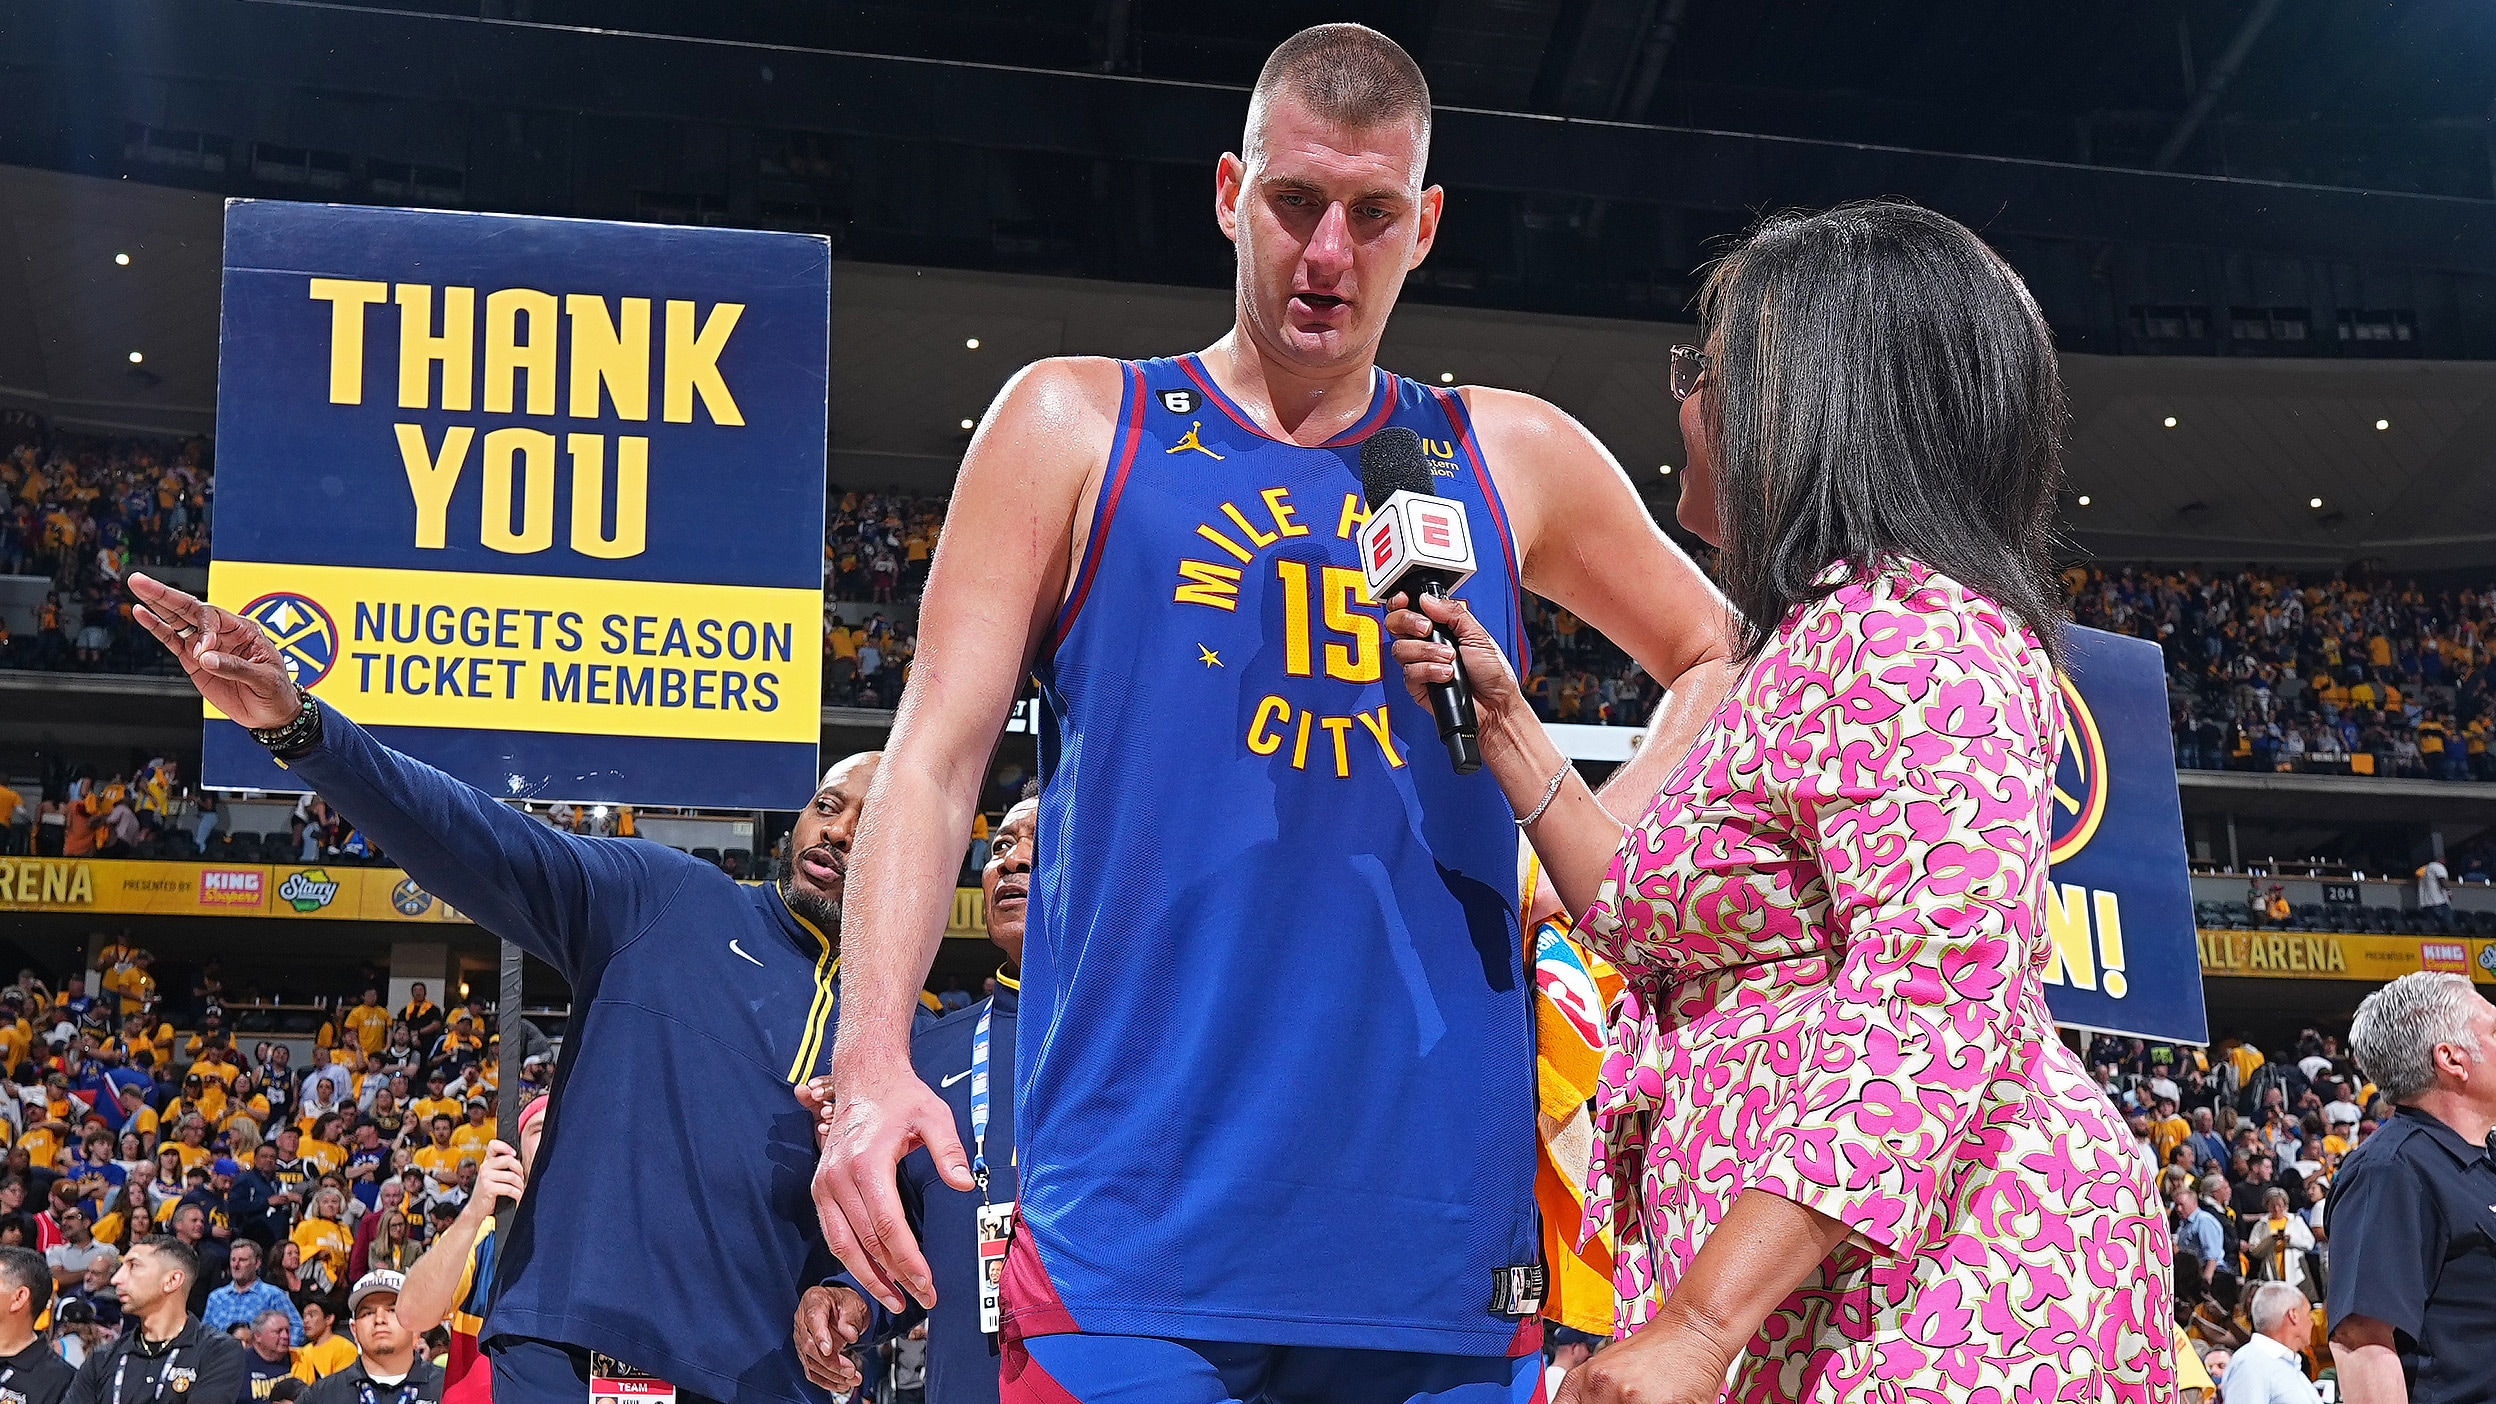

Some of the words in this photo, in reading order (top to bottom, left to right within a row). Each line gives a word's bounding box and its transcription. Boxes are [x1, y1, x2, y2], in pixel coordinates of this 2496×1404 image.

[309, 277, 746, 427] THANK
[1165, 391, 1191, 413] 6
[394, 423, 650, 560] YOU
[1173, 486, 1310, 613] MILE
[354, 601, 585, 653] NUGGETS
[600, 614, 794, 663] SEASON
[1275, 556, 1385, 685] 15
[351, 652, 526, 700] TICKET
[541, 662, 781, 713] MEMBERS
[1245, 694, 1406, 779] CITY
[0, 861, 94, 904] RENA
[205, 872, 260, 890] KING
[280, 873, 340, 906] Starry
[2329, 886, 2355, 901] 204
[2040, 880, 2128, 999] N!
[2250, 934, 2347, 972] ARENA
[2423, 944, 2465, 961] KING
[617, 1382, 648, 1393] TEAM
